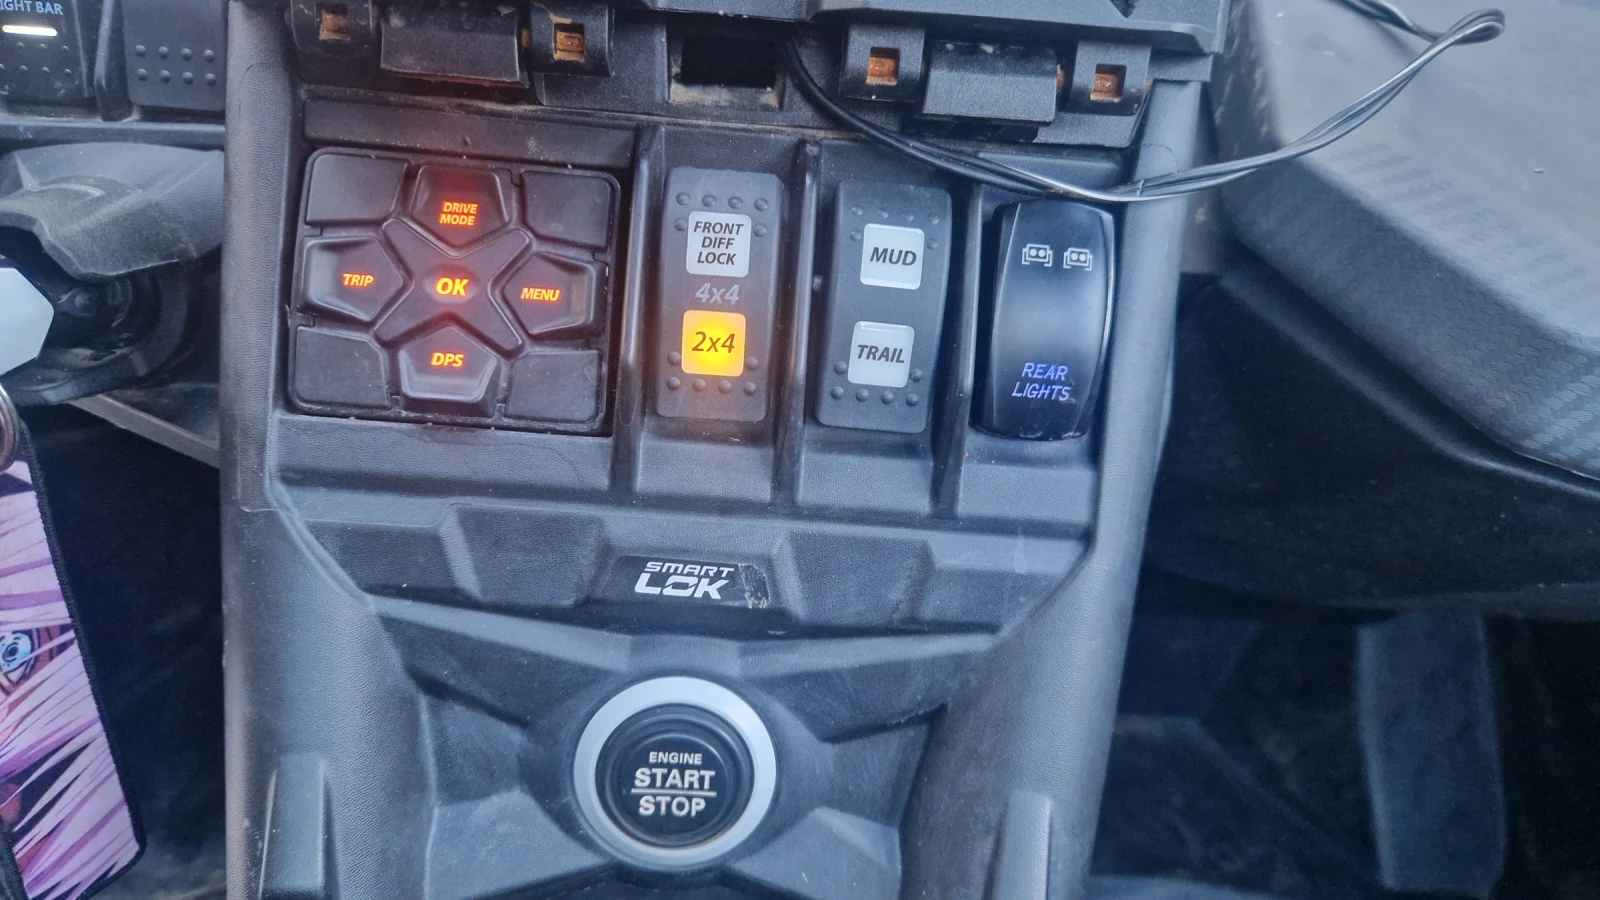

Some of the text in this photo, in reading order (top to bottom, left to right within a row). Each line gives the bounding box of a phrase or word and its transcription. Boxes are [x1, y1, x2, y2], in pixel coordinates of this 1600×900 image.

[35, 1, 64, 15] BAR
[442, 202, 478, 214] DRIVE
[439, 214, 475, 226] MODE
[693, 221, 744, 235] FRONT
[701, 236, 735, 249] DIFF
[697, 252, 737, 265] LOCK
[869, 247, 917, 266] MUD
[342, 273, 374, 287] TRIP
[435, 277, 469, 295] OK
[520, 287, 560, 301] MENU
[695, 282, 740, 305] 4x4
[691, 331, 736, 353] 2x4
[430, 352, 464, 367] DPS
[857, 344, 905, 363] TRAIL
[1021, 362, 1068, 380] REAR
[1011, 381, 1071, 400] LIGHTS
[644, 561, 734, 578] SMART
[634, 572, 729, 600] LOK
[648, 751, 703, 765] ENGINE
[634, 767, 716, 790] START
[638, 795, 706, 817] STOP
